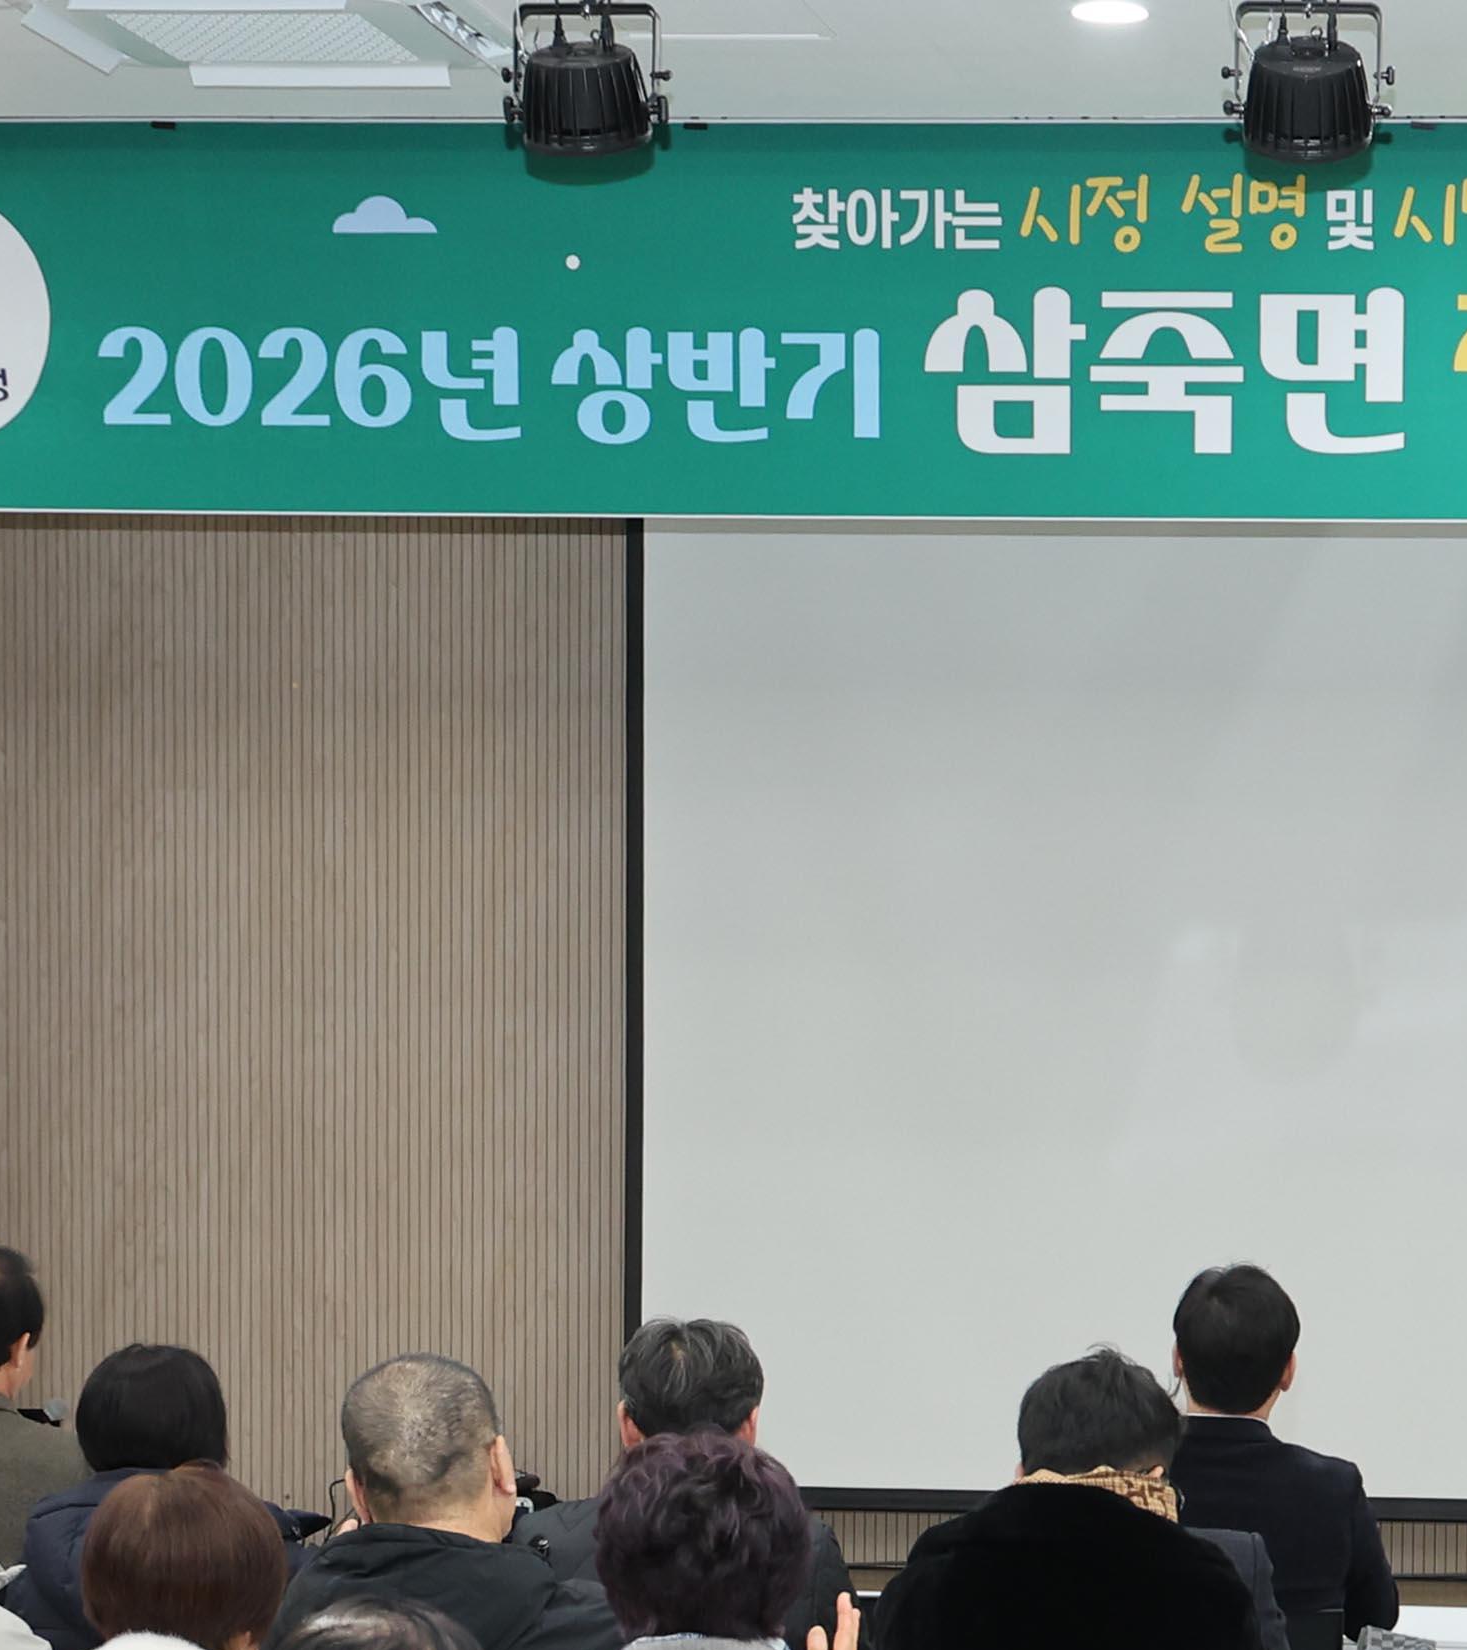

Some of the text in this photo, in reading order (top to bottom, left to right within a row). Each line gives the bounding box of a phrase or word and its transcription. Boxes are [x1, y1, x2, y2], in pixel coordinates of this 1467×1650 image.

[791, 186, 1004, 251] 찾아가는
[1018, 173, 1150, 253] 시정
[1180, 173, 1307, 254] 설명
[1325, 188, 1375, 252] 및
[98, 327, 521, 441] 2026년
[551, 327, 880, 444] 상반기
[924, 285, 1407, 456] 삼죽면
